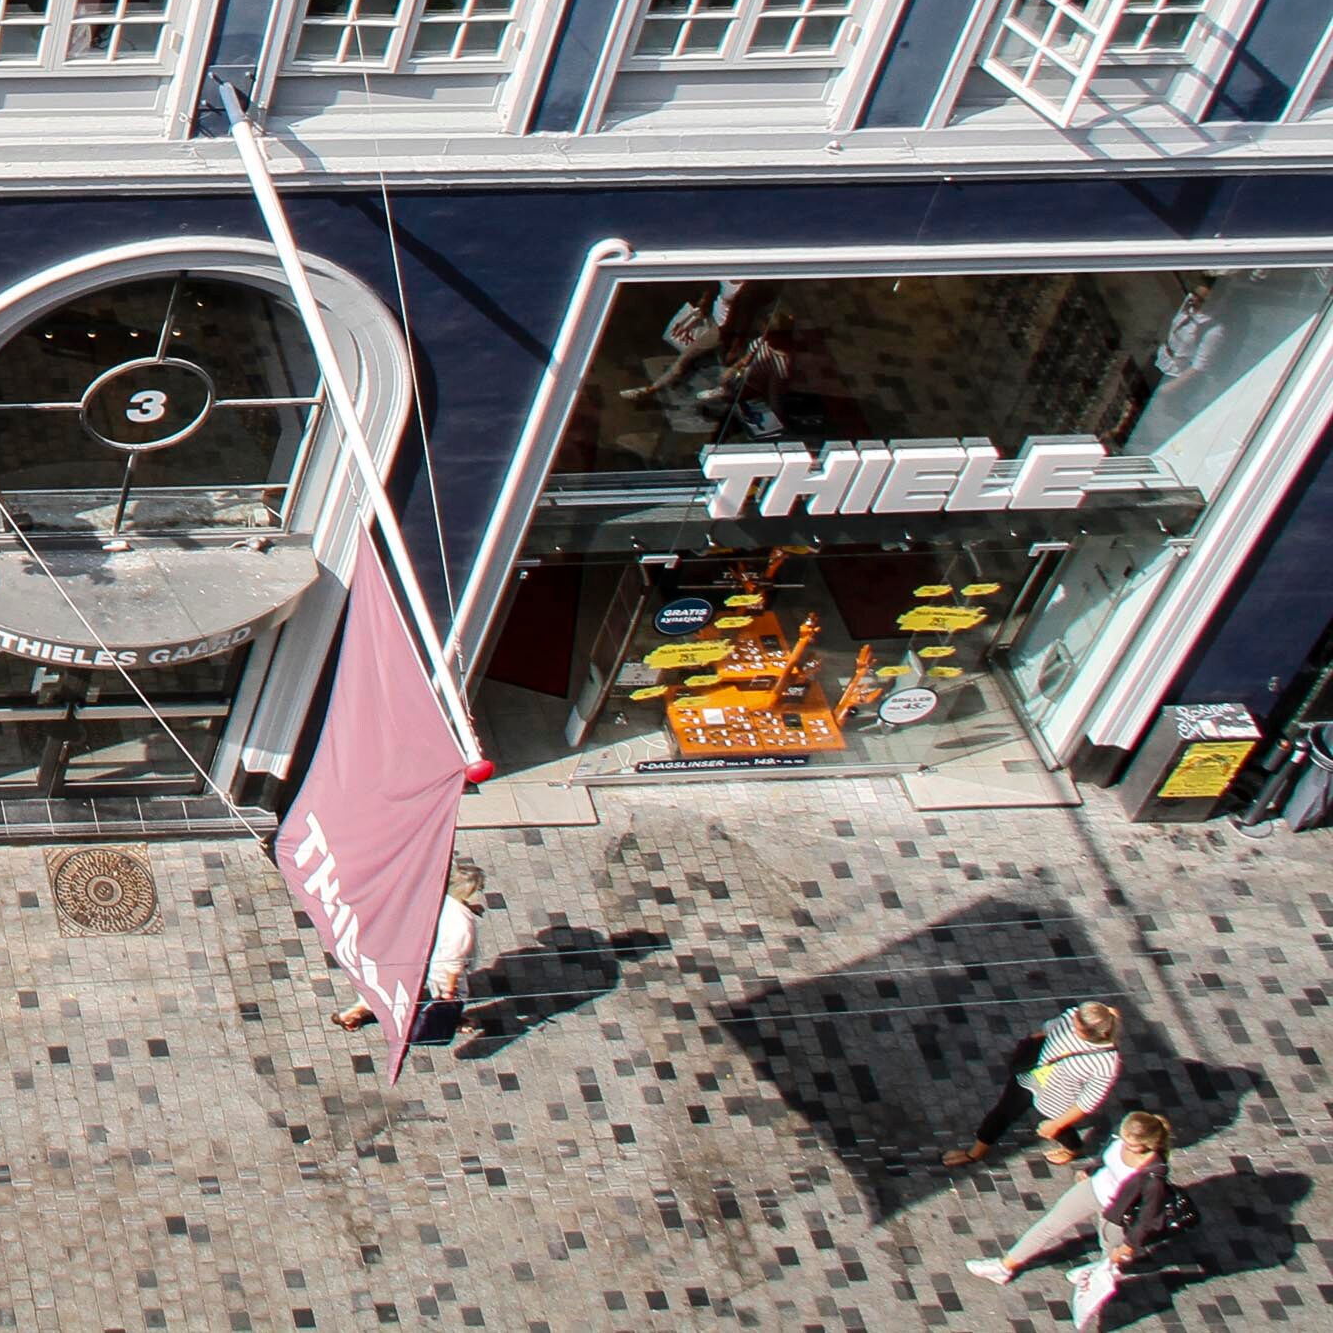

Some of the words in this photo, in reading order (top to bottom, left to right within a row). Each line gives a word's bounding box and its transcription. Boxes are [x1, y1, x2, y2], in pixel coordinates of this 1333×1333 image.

[126, 390, 167, 423] 3
[699, 435, 1107, 519] THIELE
[663, 608, 709, 617] GRATIS
[148, 626, 253, 664] GAARD
